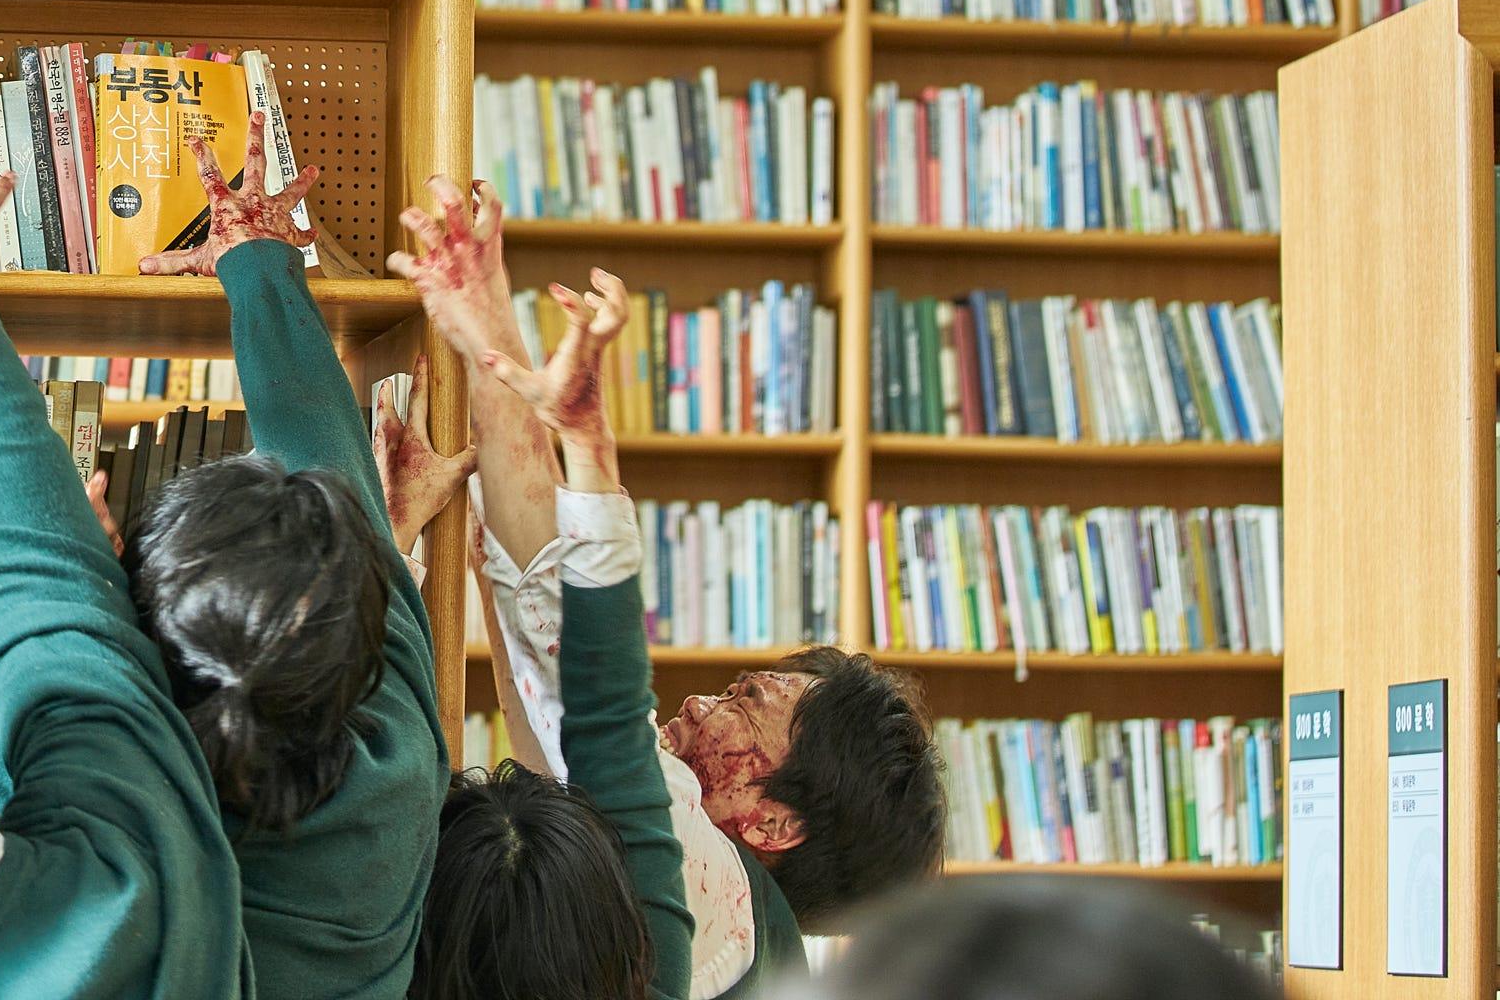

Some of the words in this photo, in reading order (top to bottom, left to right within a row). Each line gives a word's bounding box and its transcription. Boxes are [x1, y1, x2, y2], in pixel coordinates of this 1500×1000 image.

[48, 59, 61, 91] 한국의
[72, 49, 84, 84] 그대에게
[107, 66, 203, 106] 부동산
[51, 92, 67, 124] 명수필
[108, 104, 170, 142] 상식
[55, 125, 71, 148] 88선
[108, 142, 170, 178] 사전
[274, 130, 295, 177] 사랑하며
[1295, 713, 1312, 741] 800
[1395, 705, 1413, 734] 800
